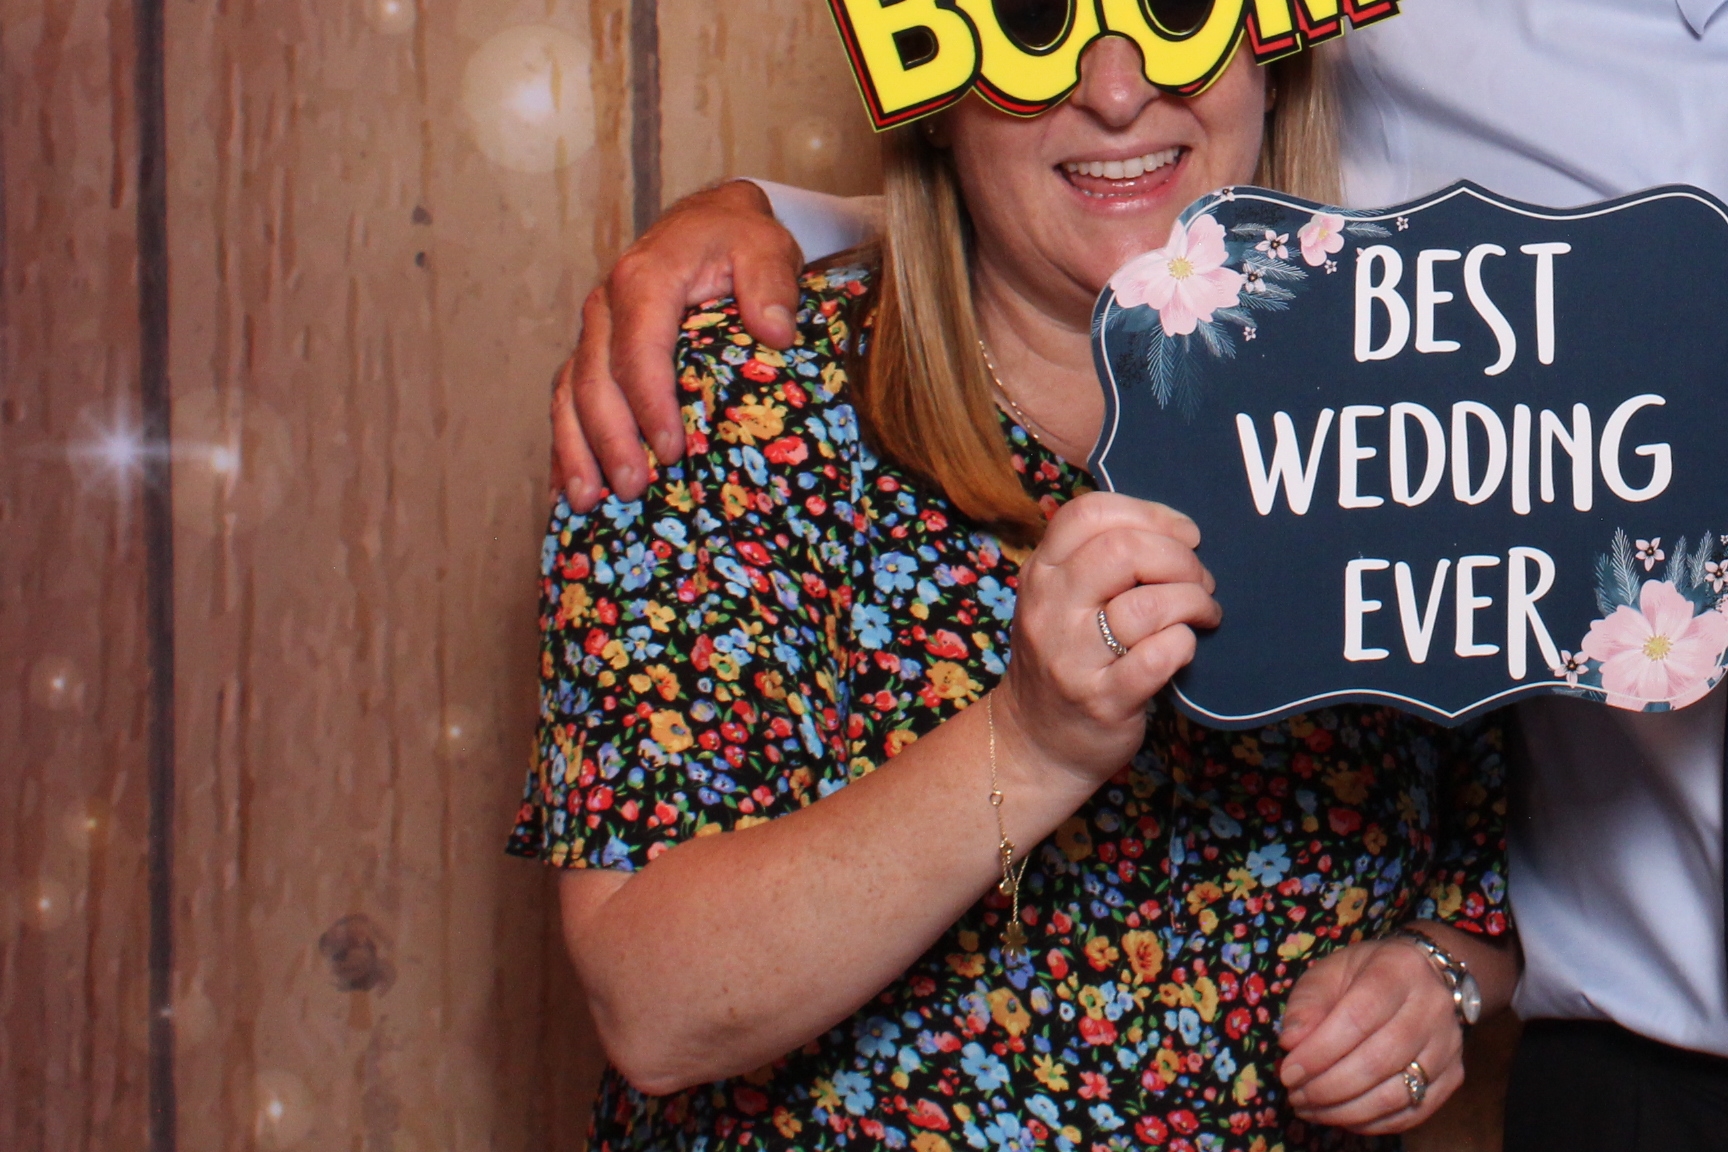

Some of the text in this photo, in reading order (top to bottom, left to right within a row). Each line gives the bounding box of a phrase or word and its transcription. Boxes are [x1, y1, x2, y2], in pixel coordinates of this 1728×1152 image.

[1353, 242, 1571, 376] BEST
[1235, 394, 1672, 516] WEDDING
[1343, 546, 1562, 680] EVER
